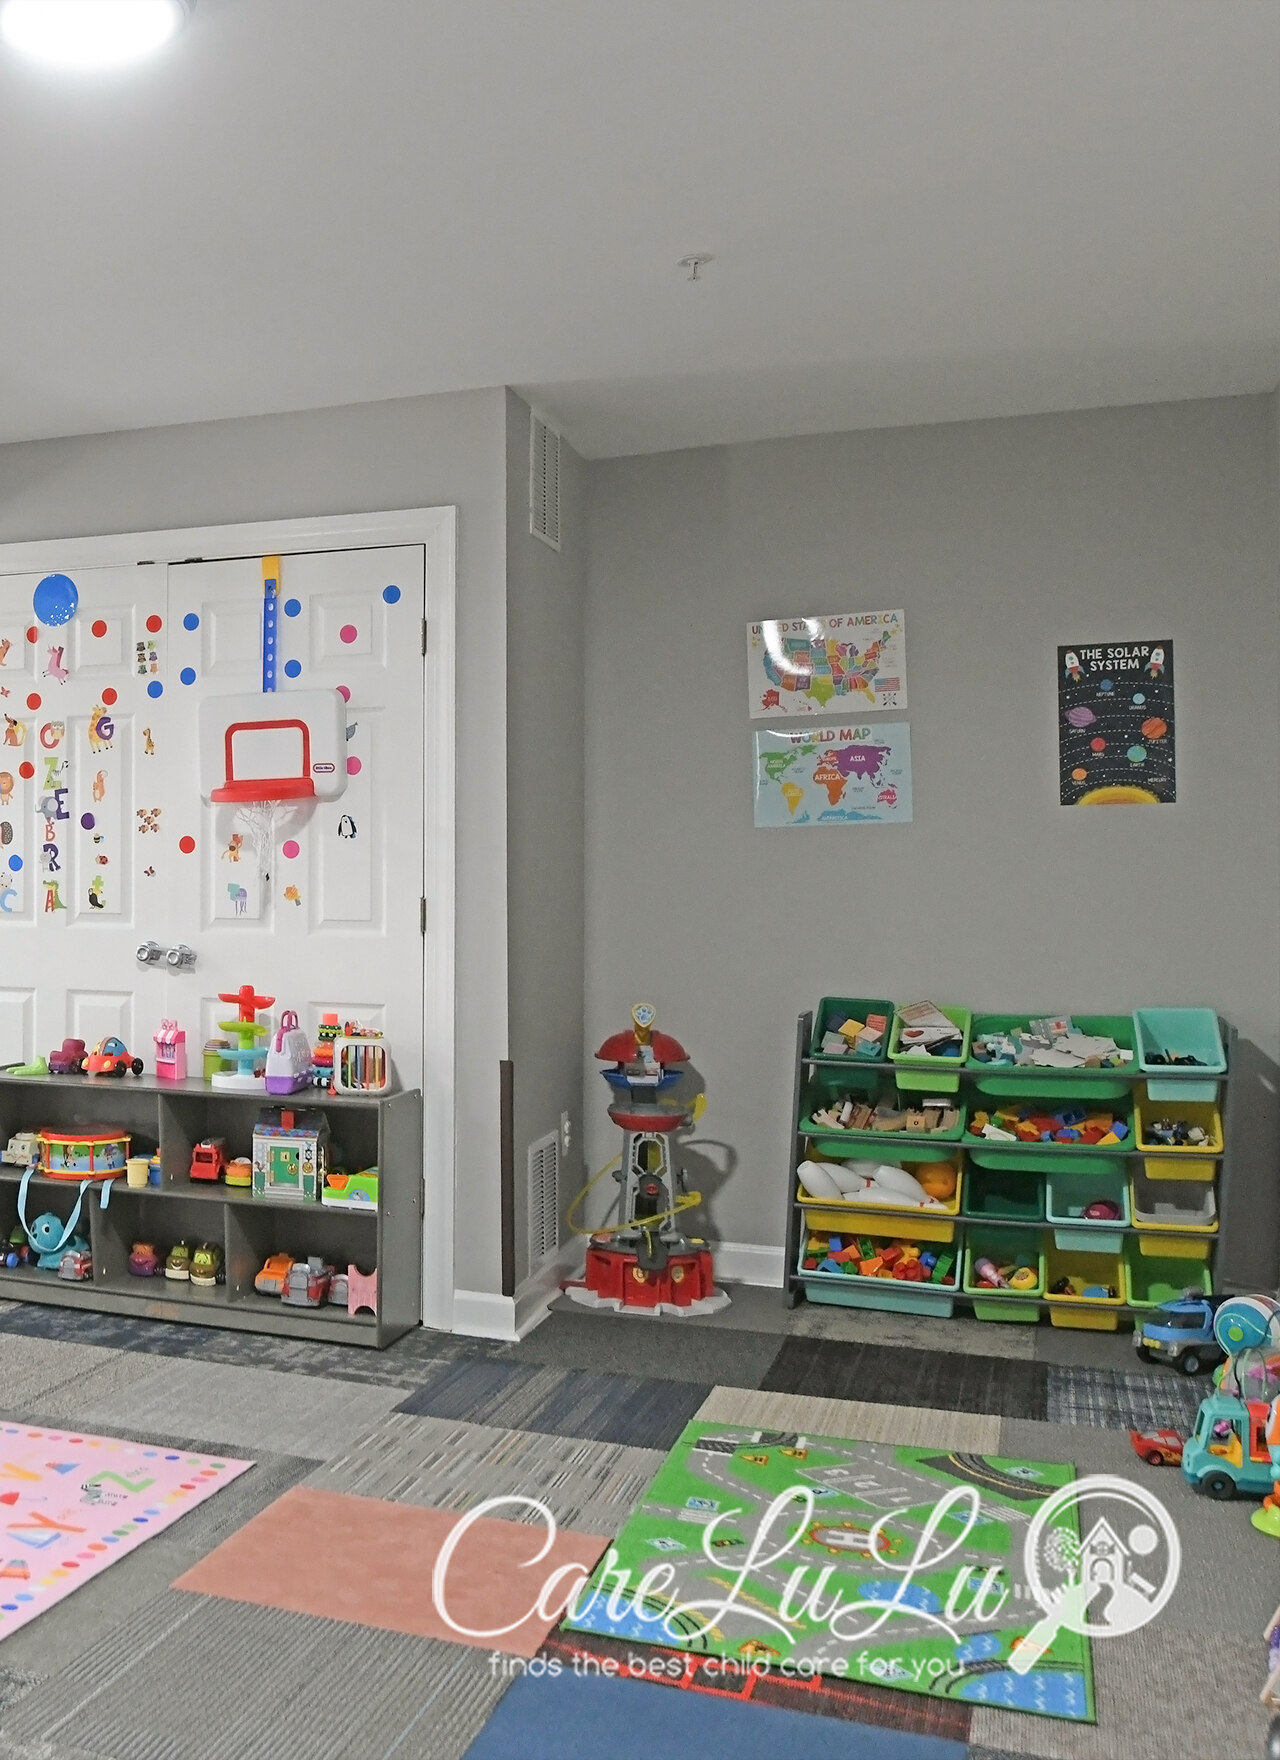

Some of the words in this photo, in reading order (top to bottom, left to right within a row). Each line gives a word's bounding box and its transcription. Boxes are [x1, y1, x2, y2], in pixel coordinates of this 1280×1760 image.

[829, 617, 843, 628] OF
[847, 613, 898, 627] AMERICA
[1080, 648, 1103, 660] THE
[1107, 646, 1150, 659] SOLAR
[1090, 659, 1140, 672] SYSTEM
[839, 727, 871, 742] MAP
[814, 773, 841, 781] AFRICA
[7, 1511, 87, 1533] Y
[87, 1470, 157, 1494] Z
